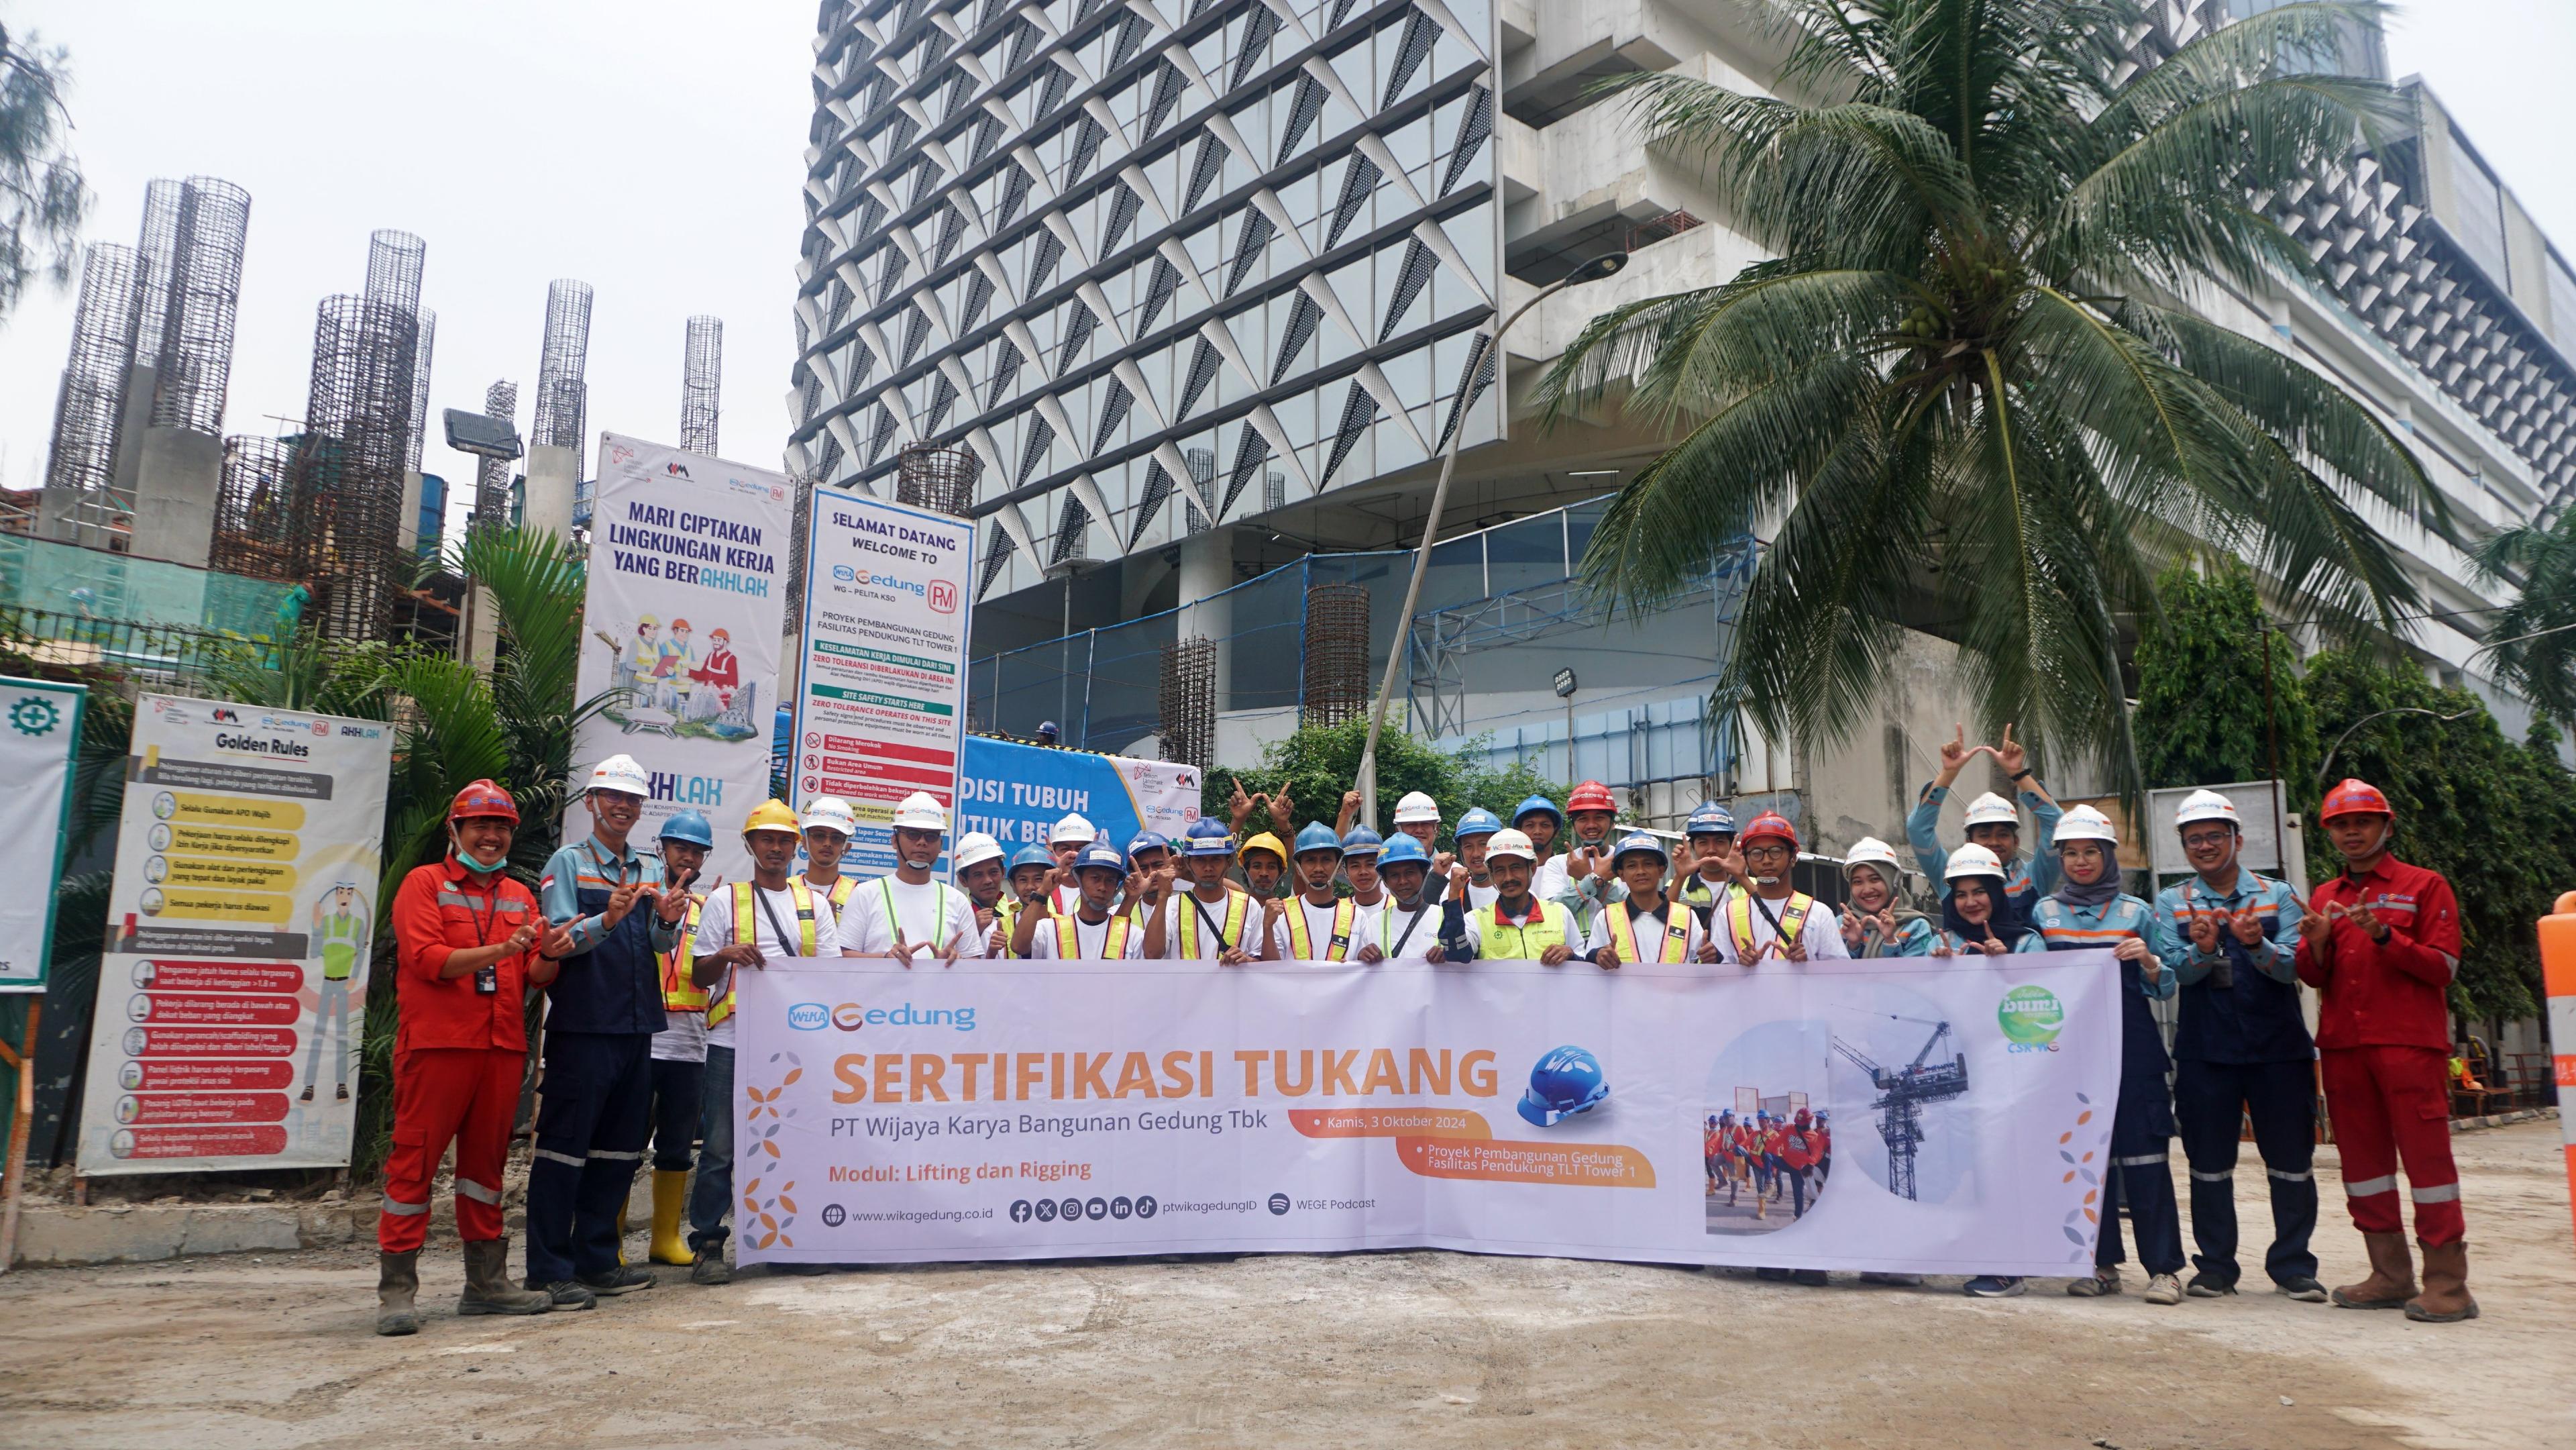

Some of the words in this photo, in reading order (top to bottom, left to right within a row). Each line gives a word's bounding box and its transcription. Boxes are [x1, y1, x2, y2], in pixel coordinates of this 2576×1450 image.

[629, 501, 675, 528] MARI
[680, 513, 762, 547] CIPTAKAN
[833, 512, 896, 537] SELAMAT
[899, 527, 956, 551] DATANG
[609, 523, 721, 563] LINGKUNGAN
[726, 547, 774, 574] KERJA
[852, 537, 918, 560] WELCOME
[921, 553, 937, 564] TO
[614, 550, 660, 578] YANG
[834, 584, 846, 593] WG
[854, 589, 879, 599] PELITA
[880, 594, 896, 603] KSO
[855, 570, 924, 597] Gedung
[817, 621, 857, 635] FASILITAS
[859, 629, 910, 644] PENDUKUNG
[912, 637, 924, 646] TLT
[926, 641, 953, 652] TOWER
[822, 611, 856, 624] PROYEK
[858, 617, 921, 635] PEMBANGUNAN
[922, 630, 955, 643] GEDUNG
[813, 654, 830, 663] ZERO
[832, 658, 869, 670] TOLERANSI
[870, 664, 919, 679] DIBERLAKUKAN
[928, 674, 944, 683] AREA
[945, 676, 954, 684] INI
[820, 642, 869, 658] KESELAMATAN
[871, 651, 891, 662] KERJA
[892, 654, 920, 666] DIMULAI
[922, 660, 937, 670] DARI
[938, 664, 951, 672] SINI
[812, 700, 831, 708] ZERO
[833, 703, 874, 715] TOLERANCE
[875, 709, 909, 719] OPERATES
[842, 691, 858, 700] SITE
[859, 694, 883, 703] SAFETY
[883, 697, 908, 708] STARTS
[908, 701, 925, 711] HERE
[864, 723, 891, 731] equipment
[865, 717, 892, 725] procedures
[215, 733, 267, 753] Golden
[270, 739, 309, 757] Rules
[828, 736, 854, 746] Dilarang
[855, 740, 881, 749] Merokok
[837, 745, 860, 753] Smoking
[648, 772, 722, 806] KHLAK
[843, 782, 887, 792] diperbolehkan
[888, 786, 910, 796] bekerja
[961, 776, 1005, 803] DISI
[1012, 782, 1089, 812] TUBUH
[1156, 806, 1183, 817] Gedung
[833, 1002, 976, 1031] Gedung
[2008, 1042, 2032, 1053] CSR
[832, 1050, 1214, 1104] SERTIFIKASI
[1234, 1047, 1498, 1098] TUKANG
[831, 1118, 860, 1137] PT
[866, 1117, 940, 1141] Wijaya
[948, 1115, 1011, 1139] Karya
[1019, 1112, 1130, 1137] Bangunan
[1138, 1110, 1223, 1134] Gedung
[1228, 1110, 1268, 1129] Tbk
[1327, 1116, 1367, 1130] Kamis,
[1371, 1117, 1379, 1128] 3
[1383, 1115, 1433, 1128] Oktober
[1435, 1117, 1466, 1129] 2024
[1428, 1144, 1470, 1159] Proyek
[1474, 1147, 1568, 1164] Pembangunan
[1571, 1151, 1623, 1167] Gedung
[1428, 1157, 1477, 1171] Fasilitas
[1481, 1161, 1554, 1177] Pendukung
[1558, 1163, 1579, 1175] TLT
[1584, 1166, 1625, 1178] Tower
[1629, 1166, 1635, 1178] 1
[829, 1165, 900, 1182] Modul:
[906, 1163, 971, 1184] Lifting
[976, 1163, 1014, 1180] dan
[1020, 1160, 1091, 1181] Rigging
[853, 1208, 993, 1224] www.wikagedung.co.id
[1163, 1199, 1258, 1215] ptwikagedungID
[1297, 1199, 1328, 1210] WEGE
[1330, 1198, 1376, 1210] Podcast
